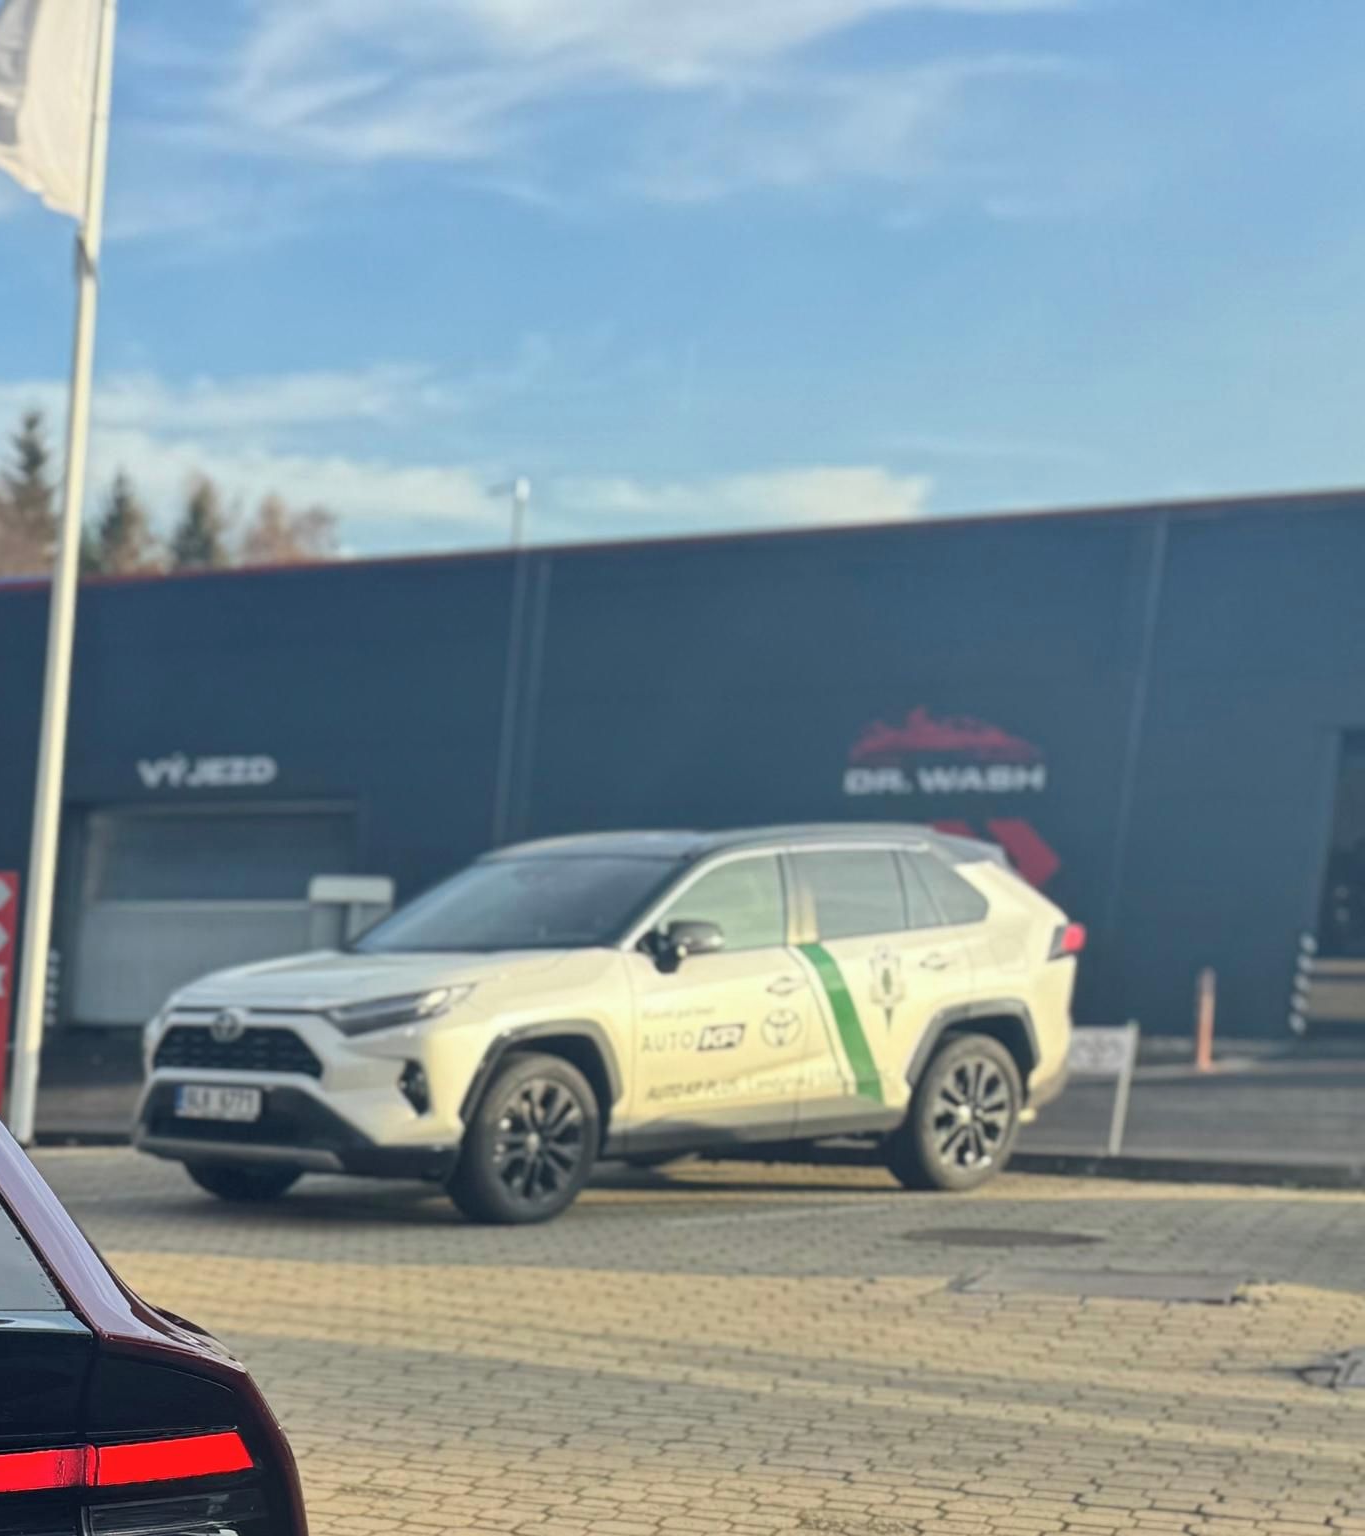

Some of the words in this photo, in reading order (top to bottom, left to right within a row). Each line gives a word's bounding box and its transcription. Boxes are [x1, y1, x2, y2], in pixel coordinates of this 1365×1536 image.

[136, 751, 277, 788] VÝJEZD
[843, 768, 914, 795] DR.
[916, 764, 1047, 793] WASH
[641, 1031, 695, 1053] AUTO
